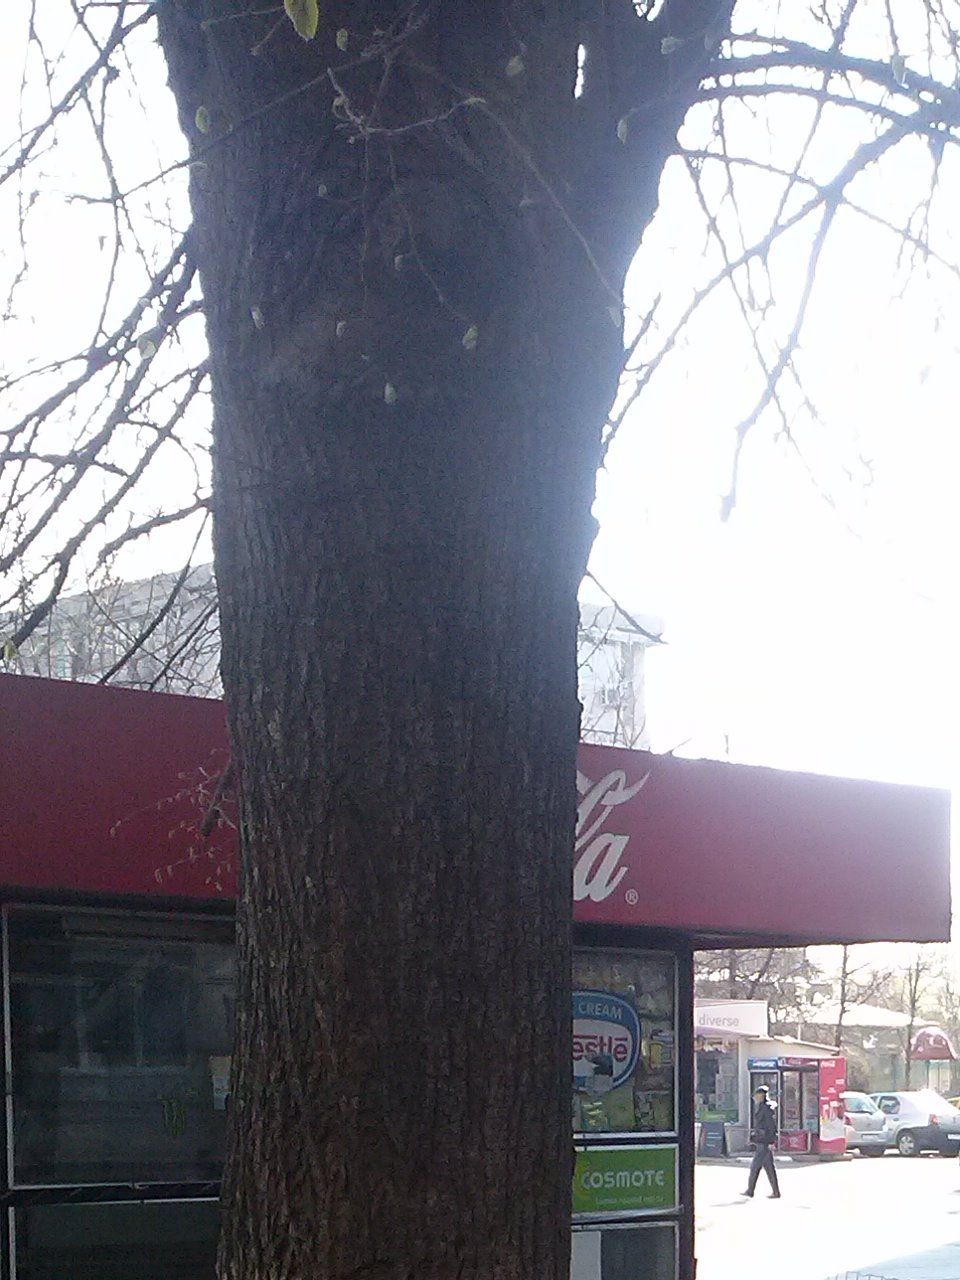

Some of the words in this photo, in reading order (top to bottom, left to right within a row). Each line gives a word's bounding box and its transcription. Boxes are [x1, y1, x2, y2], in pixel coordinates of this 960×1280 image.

[578, 1003, 622, 1020] CREAM
[698, 1013, 739, 1027] diverse
[582, 1169, 665, 1190] COSMOTE
